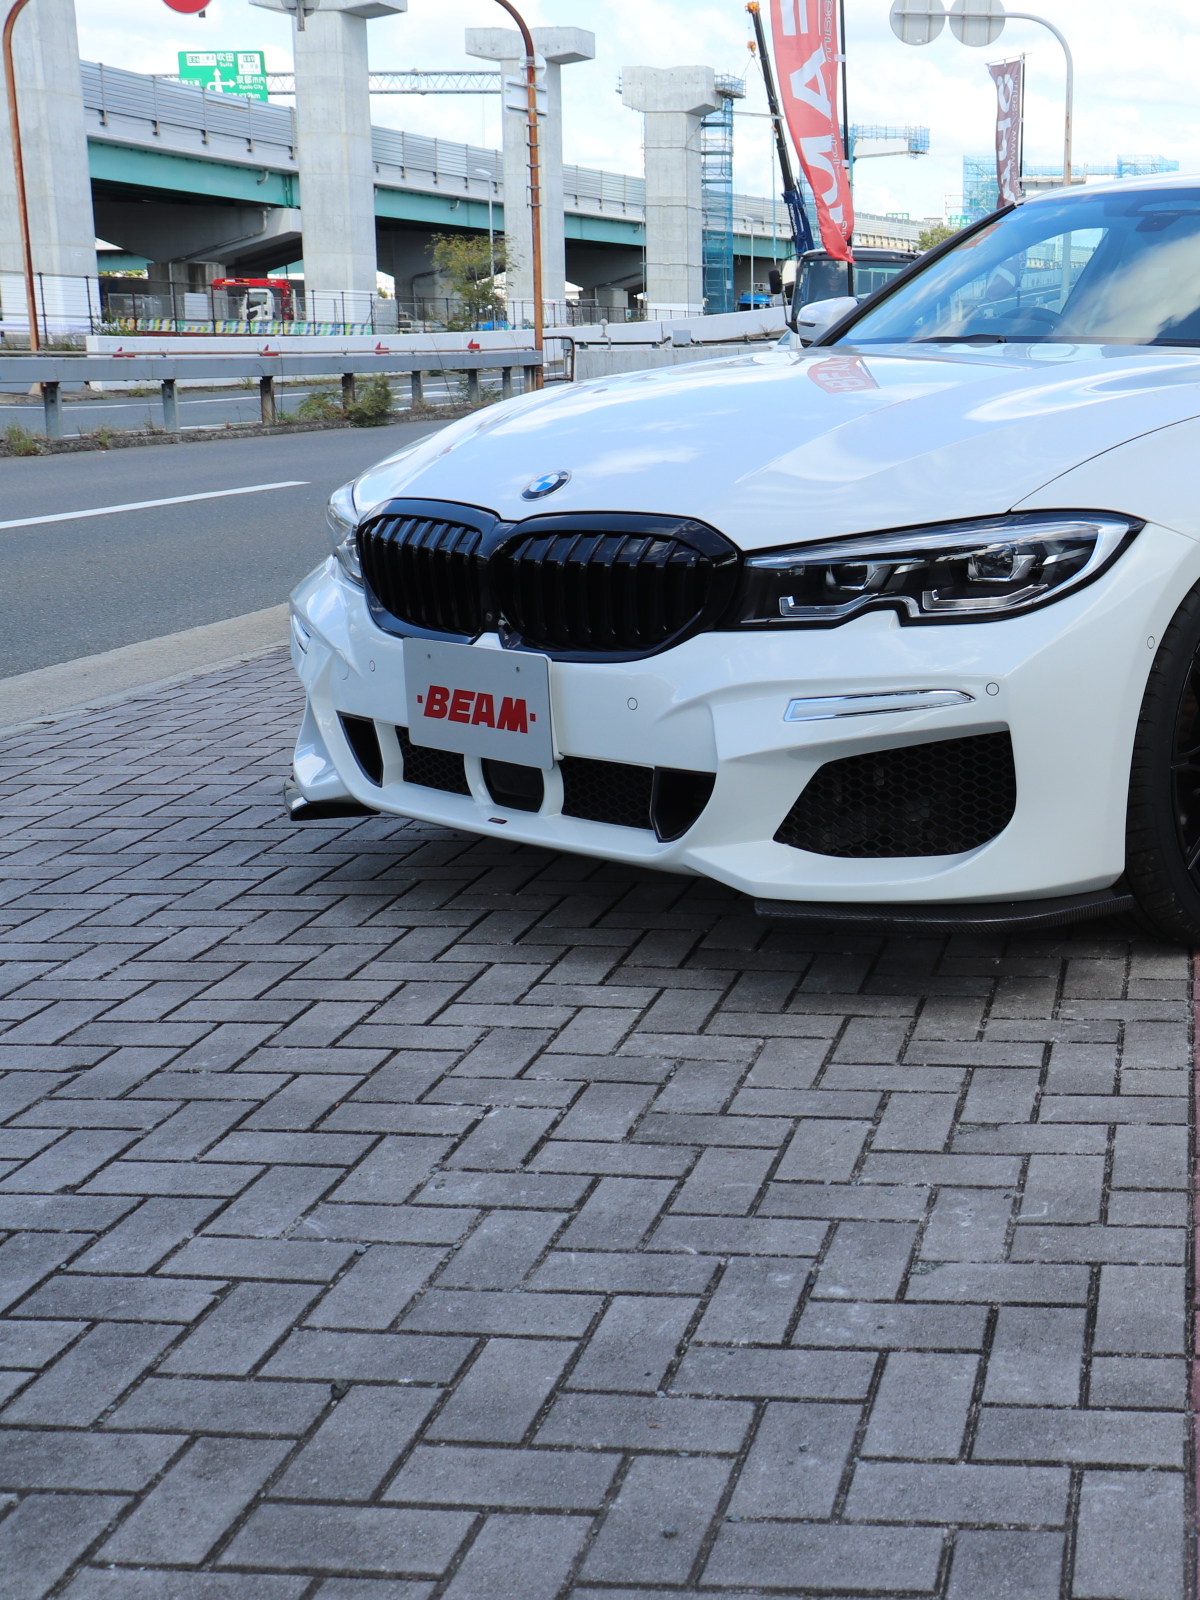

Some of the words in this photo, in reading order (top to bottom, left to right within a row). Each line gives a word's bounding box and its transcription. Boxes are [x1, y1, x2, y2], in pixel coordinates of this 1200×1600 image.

[217, 52, 234, 61] 吹田
[236, 75, 265, 84] 京都市内
[421, 684, 530, 734] BEAM
